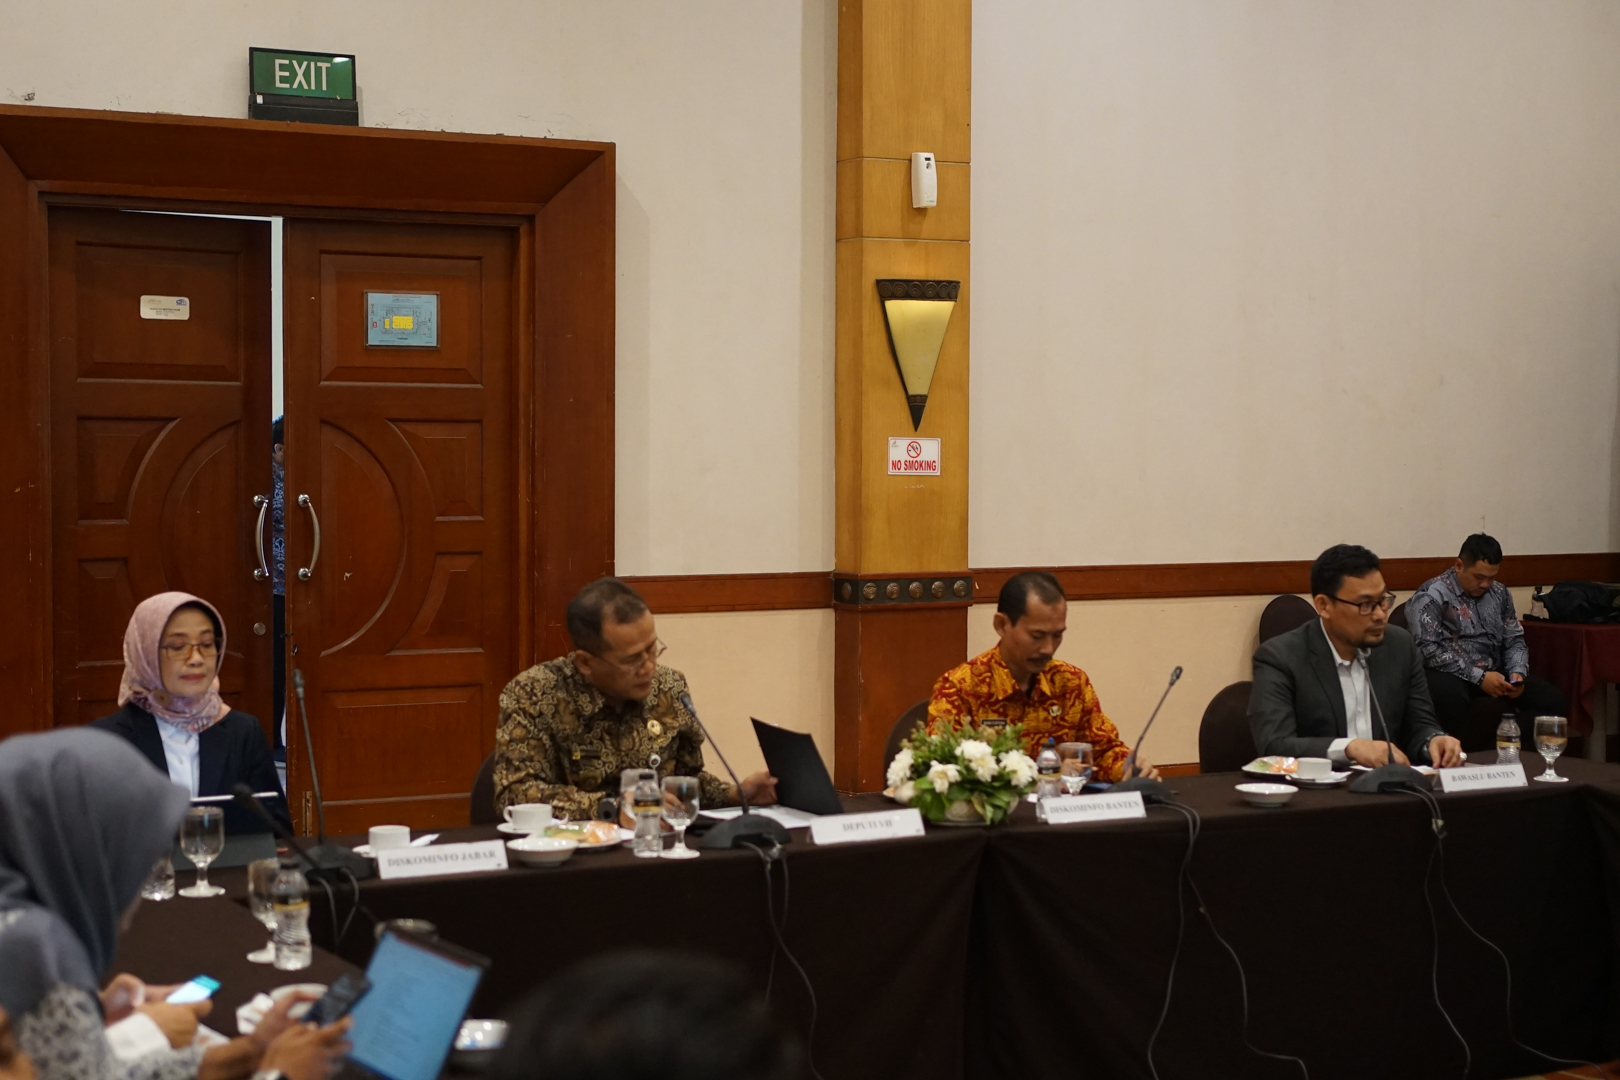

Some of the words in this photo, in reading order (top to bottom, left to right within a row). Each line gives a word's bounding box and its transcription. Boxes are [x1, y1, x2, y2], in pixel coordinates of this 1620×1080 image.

[274, 58, 331, 91] EXIT
[891, 459, 902, 471] NO
[903, 459, 937, 472] SMOKING
[1451, 773, 1485, 783] BAWASLU
[1487, 771, 1516, 780] BANTEN
[1049, 802, 1105, 814] DISKOMINFO
[1106, 800, 1140, 811] BANTEN
[842, 820, 877, 832] DEPUTI
[879, 819, 893, 828] VII
[387, 852, 459, 867] DISKOMINFO
[461, 849, 497, 861] JABAR
